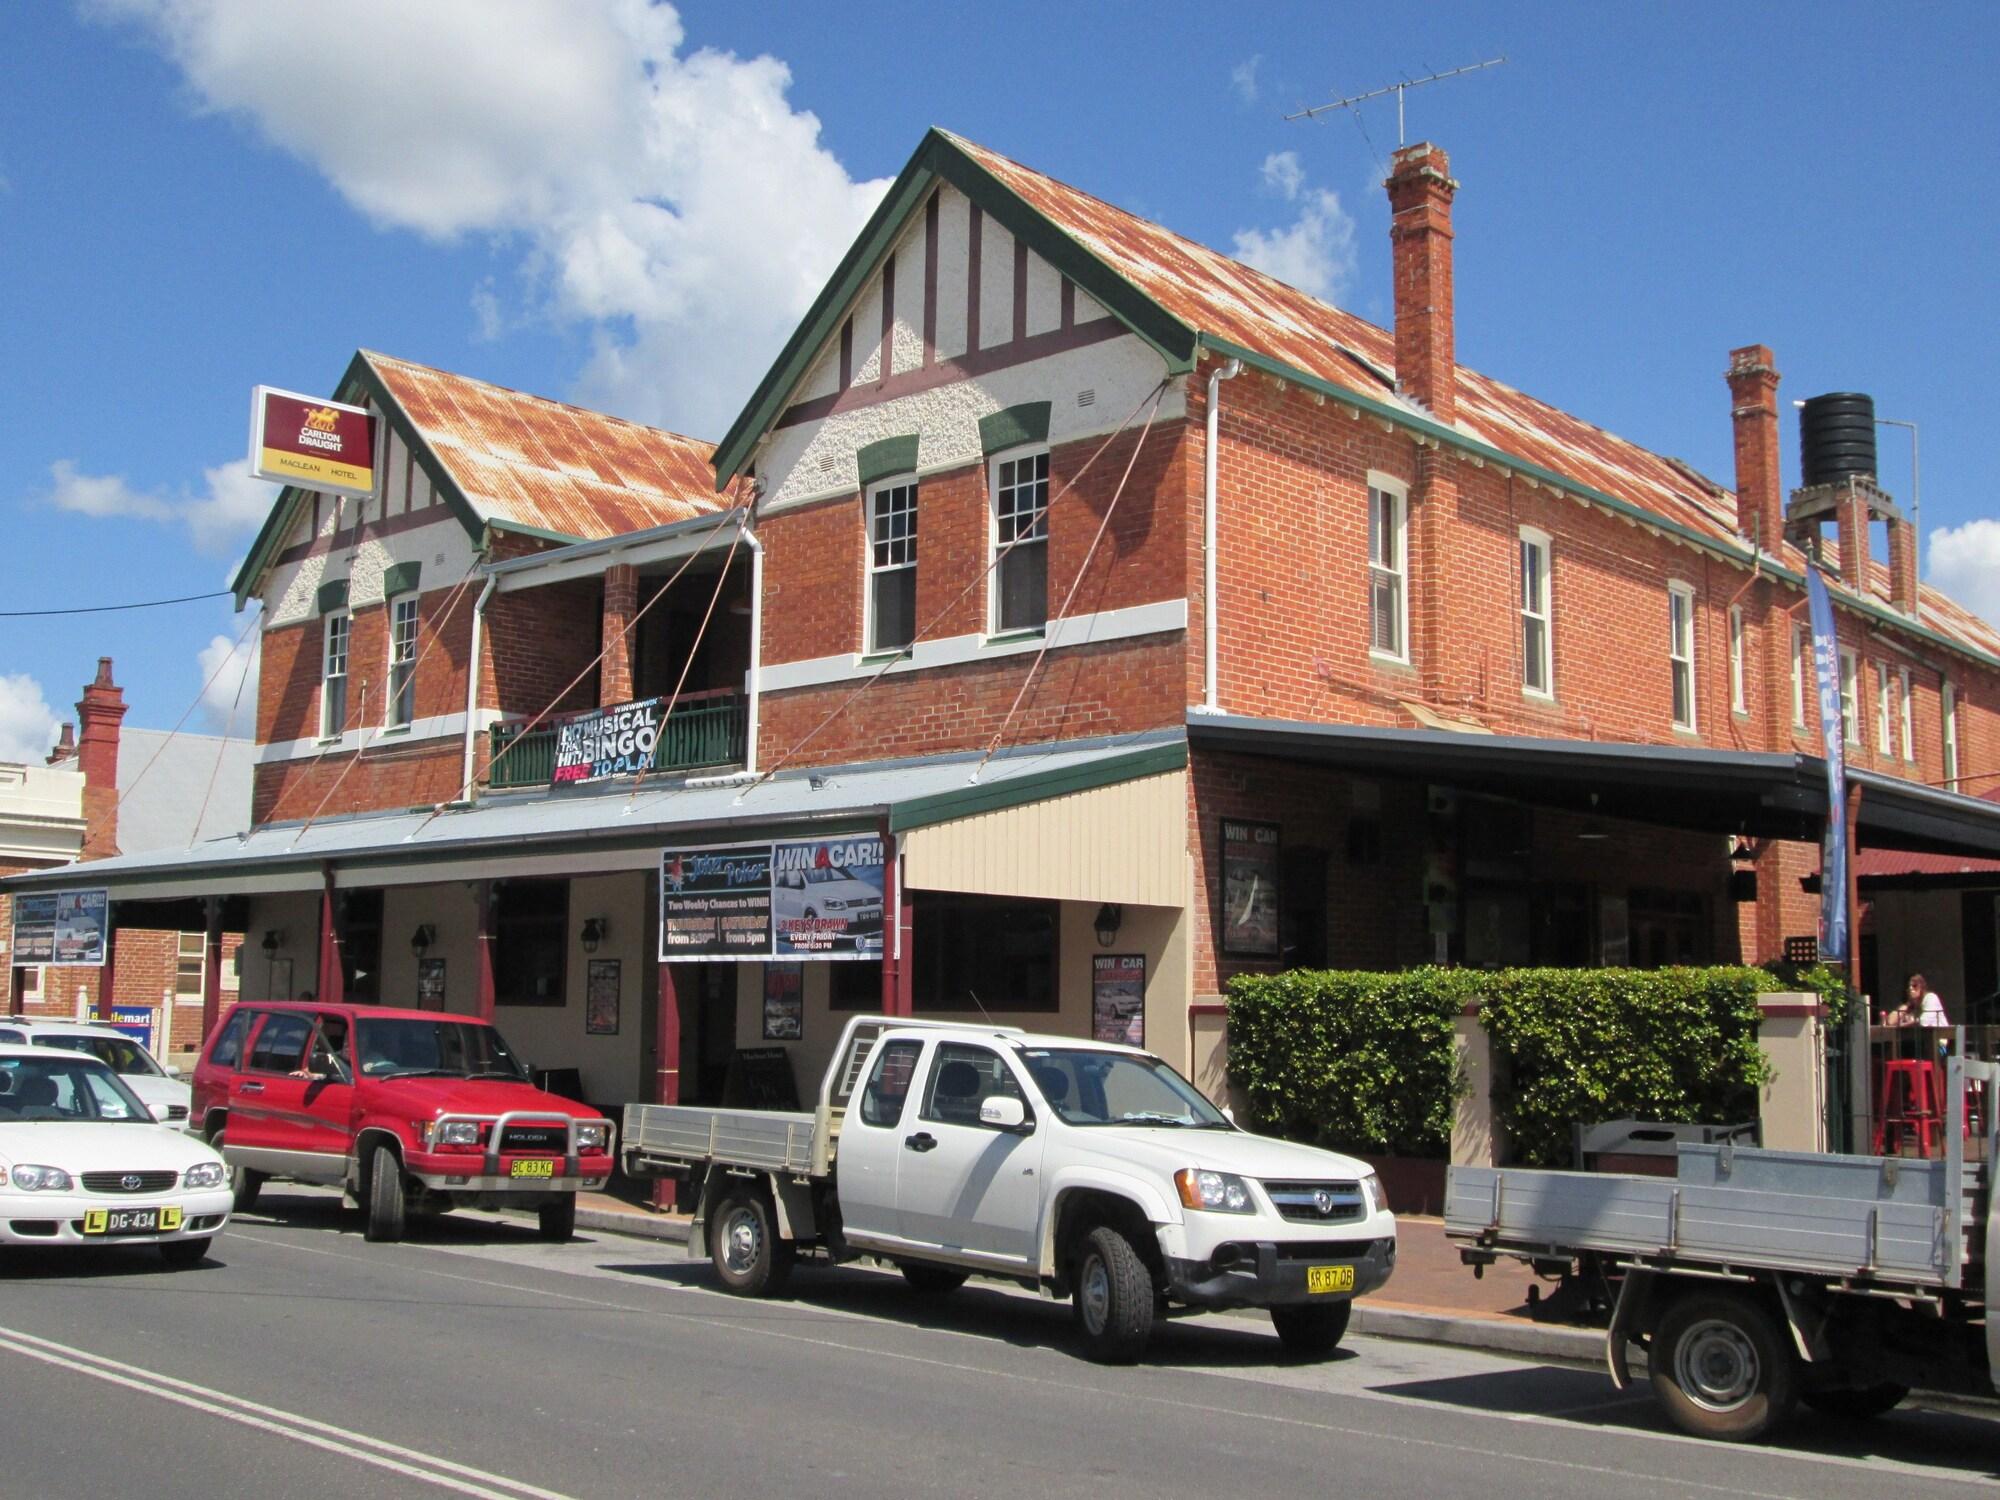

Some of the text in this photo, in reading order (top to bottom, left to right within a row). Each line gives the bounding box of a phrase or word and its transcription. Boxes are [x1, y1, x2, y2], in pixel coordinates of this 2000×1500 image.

[301, 428, 340, 441] CARLTON
[299, 435, 342, 451] DRAUGHT
[280, 458, 357, 480] MACLEAN HOTEL
[583, 708, 657, 739] MUSICAL
[583, 727, 656, 763] BINGO
[555, 764, 593, 782] FREE
[593, 760, 612, 776] TO
[614, 752, 657, 772] PLAY
[1224, 823, 1248, 841] WIN
[778, 847, 816, 870] WIN
[816, 847, 832, 869] A
[668, 901, 683, 911] Two
[684, 899, 708, 912] Weekly
[710, 898, 738, 909] Chances
[739, 898, 747, 907] to
[788, 919, 813, 931] KEYS
[668, 933, 689, 944] from
[726, 932, 746, 943] from
[746, 932, 766, 945] 5pm
[790, 932, 836, 941] EVERY FRIDAY
[794, 942, 810, 950] FROM
[1095, 959, 1144, 969] WIN CAR
[527, 1161, 538, 1173] 83
[88, 1213, 101, 1229] L
[110, 1213, 156, 1229] DG-434
[163, 1210, 176, 1226] L
